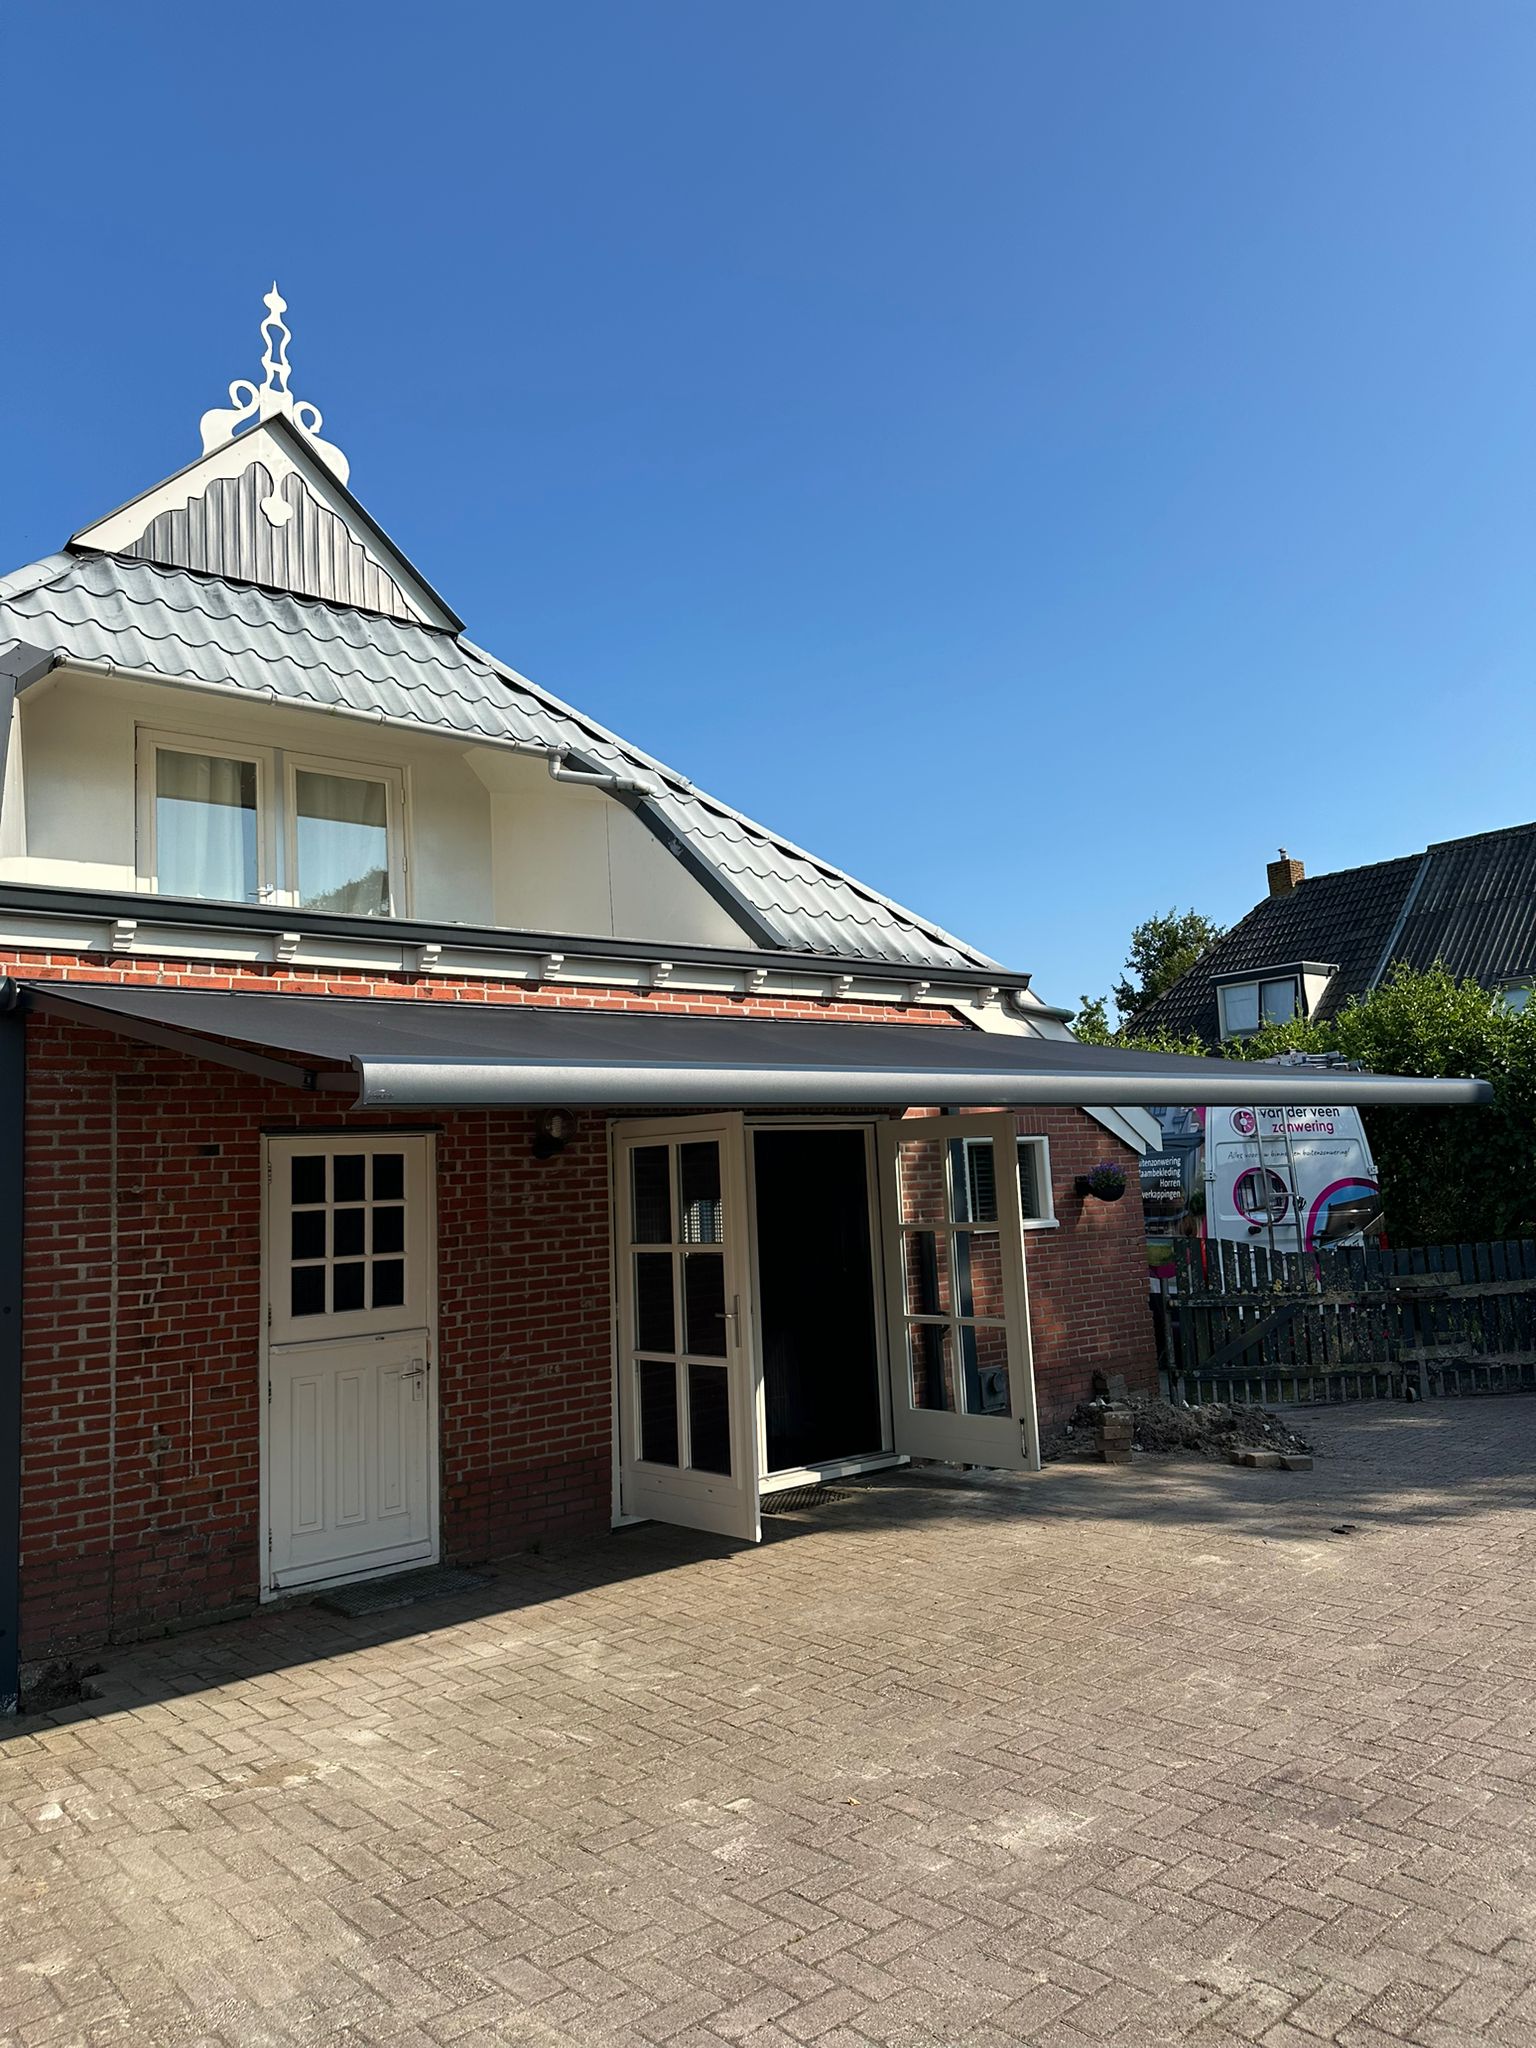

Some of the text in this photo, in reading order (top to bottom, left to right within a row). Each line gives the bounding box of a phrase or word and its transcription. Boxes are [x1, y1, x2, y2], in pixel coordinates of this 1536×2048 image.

[1287, 1106, 1307, 1117] der
[1310, 1107, 1340, 1117] veen
[1160, 1179, 1181, 1187] Horren
[1142, 1190, 1181, 1200] verkappingen
